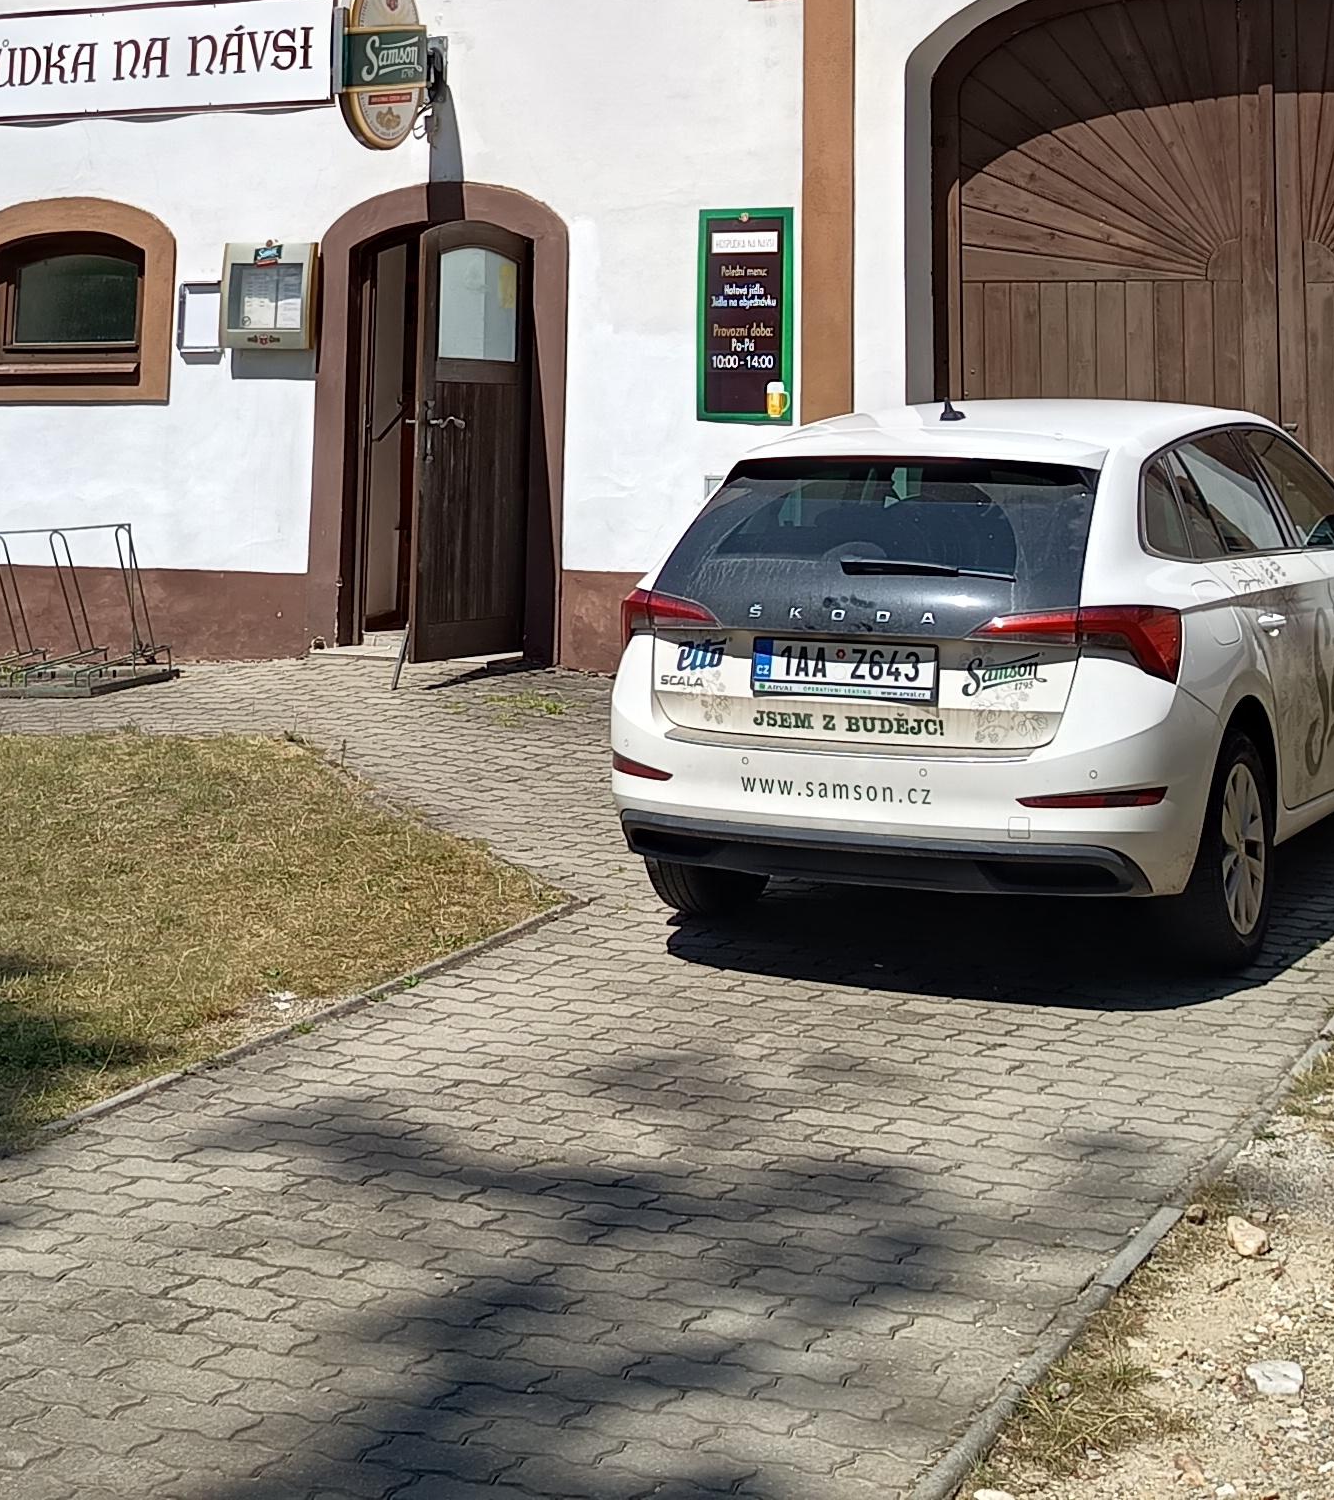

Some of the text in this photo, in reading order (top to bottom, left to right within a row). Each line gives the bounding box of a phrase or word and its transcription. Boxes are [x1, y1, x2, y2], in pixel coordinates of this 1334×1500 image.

[112, 36, 170, 81] NA
[186, 24, 315, 77] NÁVSI
[361, 35, 422, 82] Samson
[728, 299, 738, 307] na
[713, 321, 774, 337] Provozní doba:
[731, 337, 756, 352] Po-Pá
[712, 355, 739, 369] 10:00
[745, 355, 774, 369] 14:00
[748, 604, 936, 625] ŠKODA
[756, 664, 770, 675] CZ
[780, 645, 920, 682] 1AA Z643
[660, 675, 704, 688] SCALA
[962, 656, 1047, 697] Samson
[1014, 681, 1034, 691] 1795
[753, 710, 945, 736] JSEM Z BUDĚJC!
[740, 776, 932, 805] www.samson.cz
